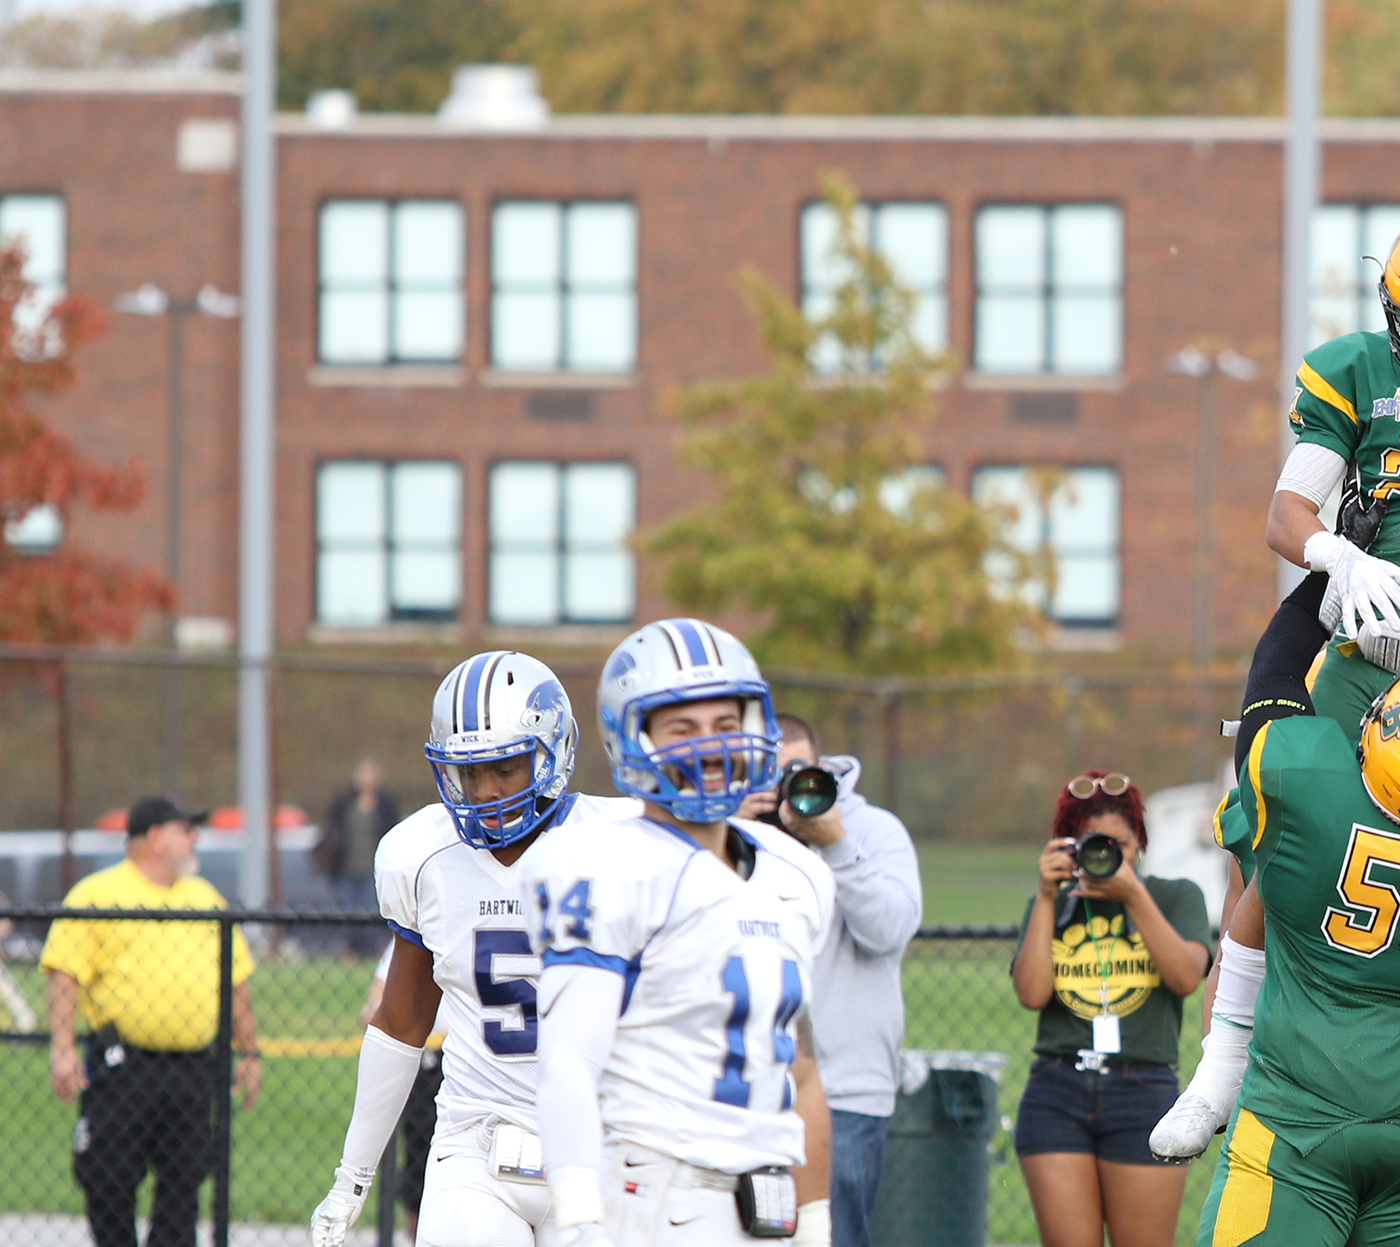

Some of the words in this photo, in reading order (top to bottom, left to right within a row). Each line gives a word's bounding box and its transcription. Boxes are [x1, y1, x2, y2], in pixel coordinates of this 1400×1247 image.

[461, 735, 480, 744] WICK
[534, 876, 596, 944] 14
[738, 919, 782, 939] HARTWICK
[473, 929, 538, 1057] 5
